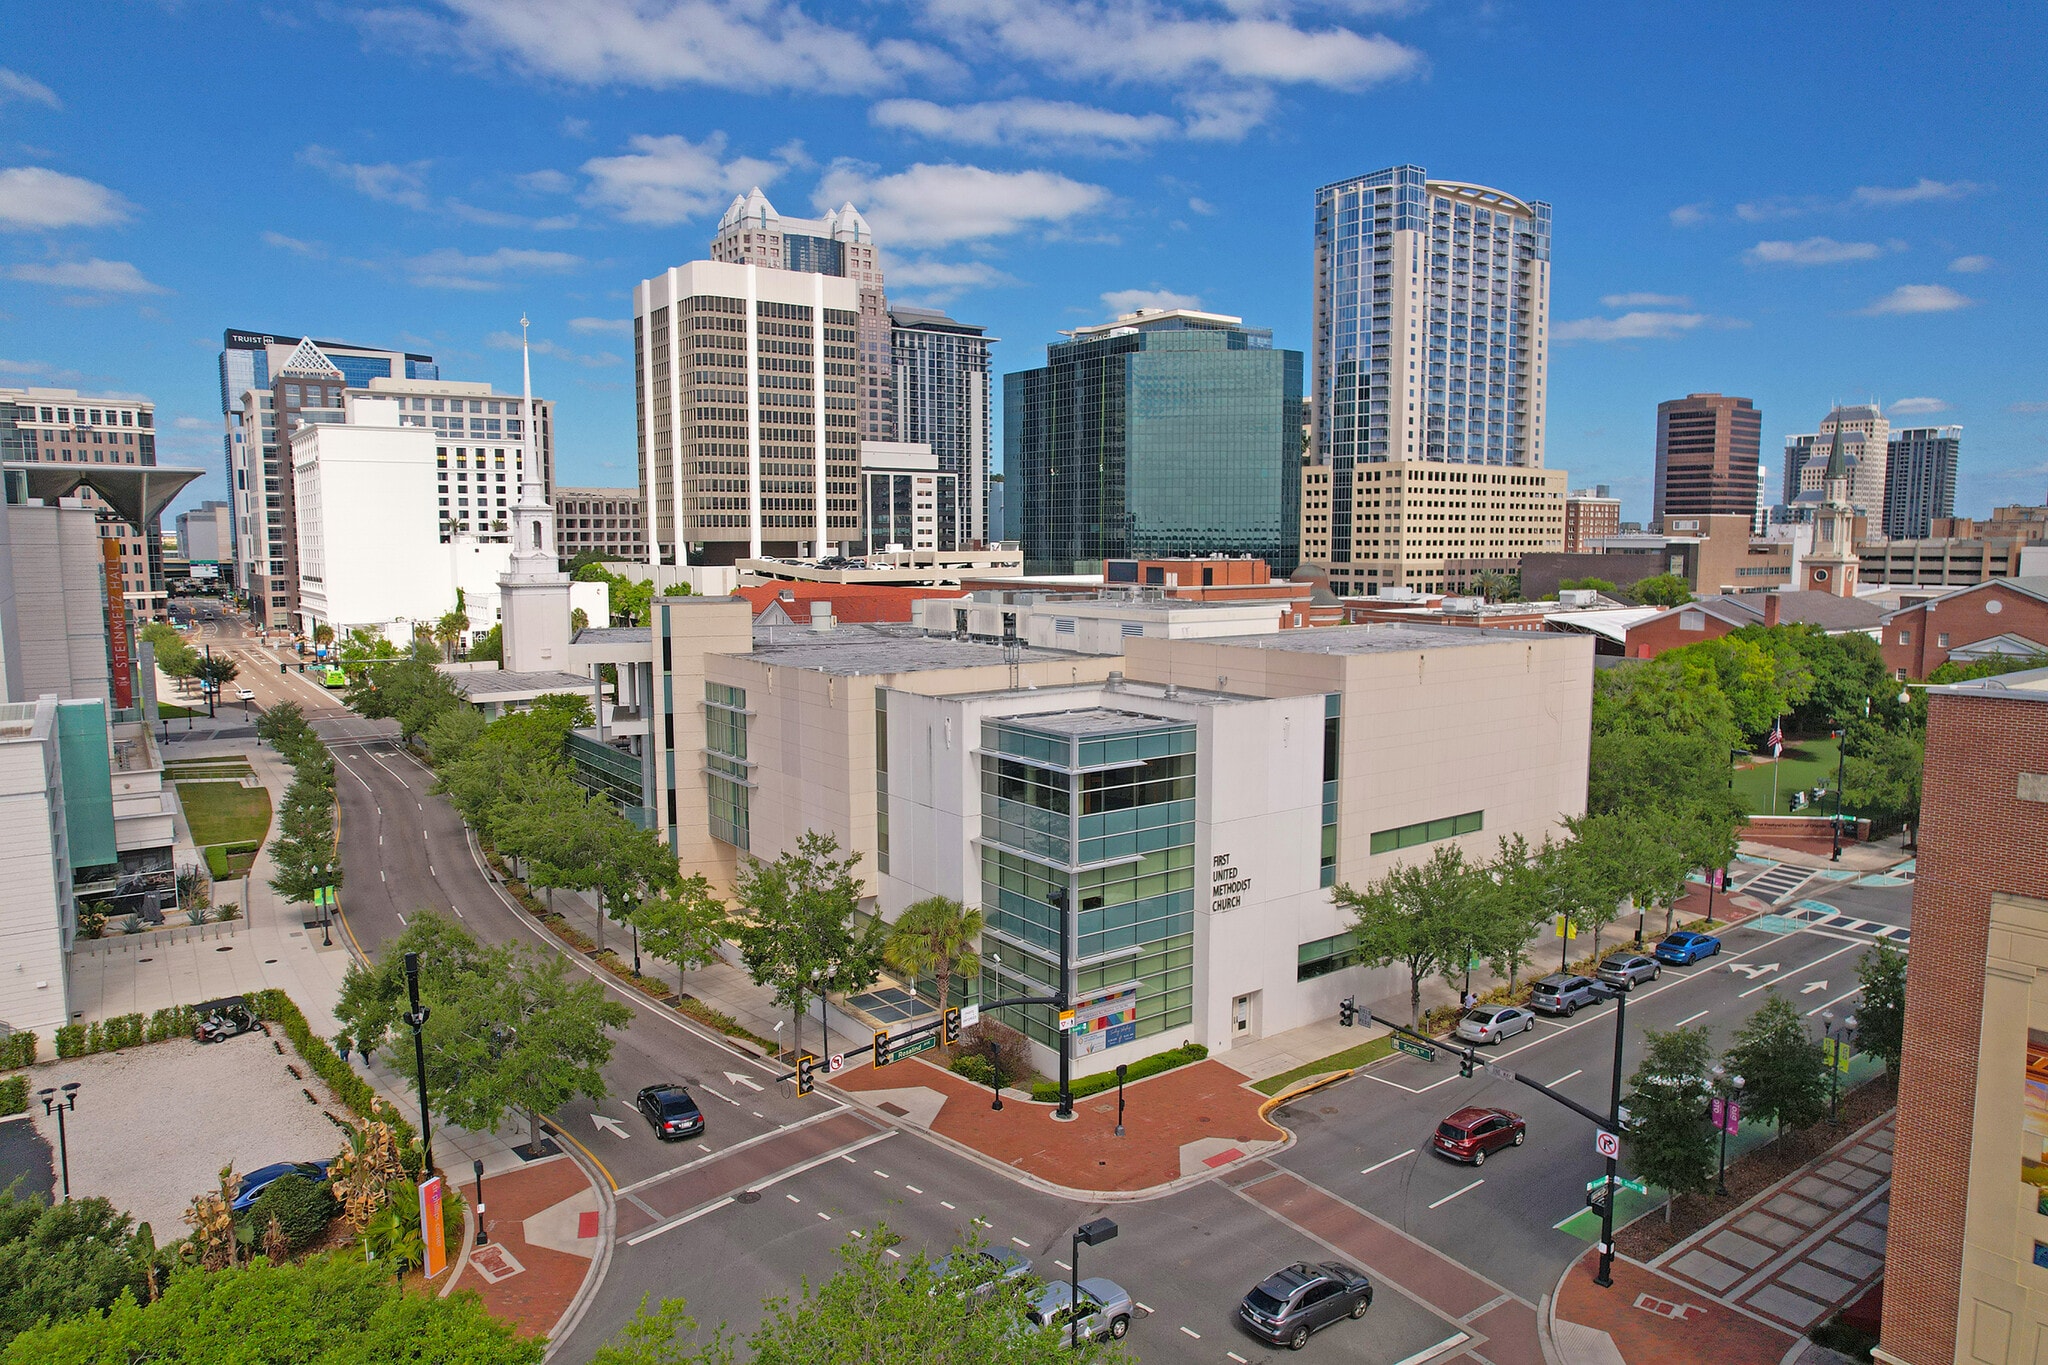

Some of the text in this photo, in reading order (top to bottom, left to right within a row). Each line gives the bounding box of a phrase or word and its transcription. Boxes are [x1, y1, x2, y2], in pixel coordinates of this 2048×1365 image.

[232, 335, 262, 344] TRUIST
[108, 556, 128, 668] STEINMETZ HALL
[1213, 853, 1230, 867] FIRST
[1212, 867, 1238, 882] UNITED
[1212, 879, 1251, 897] METHODIST
[1212, 895, 1241, 912] CHURCH
[898, 1044, 922, 1058] Rosalind
[1403, 1044, 1420, 1055] South
